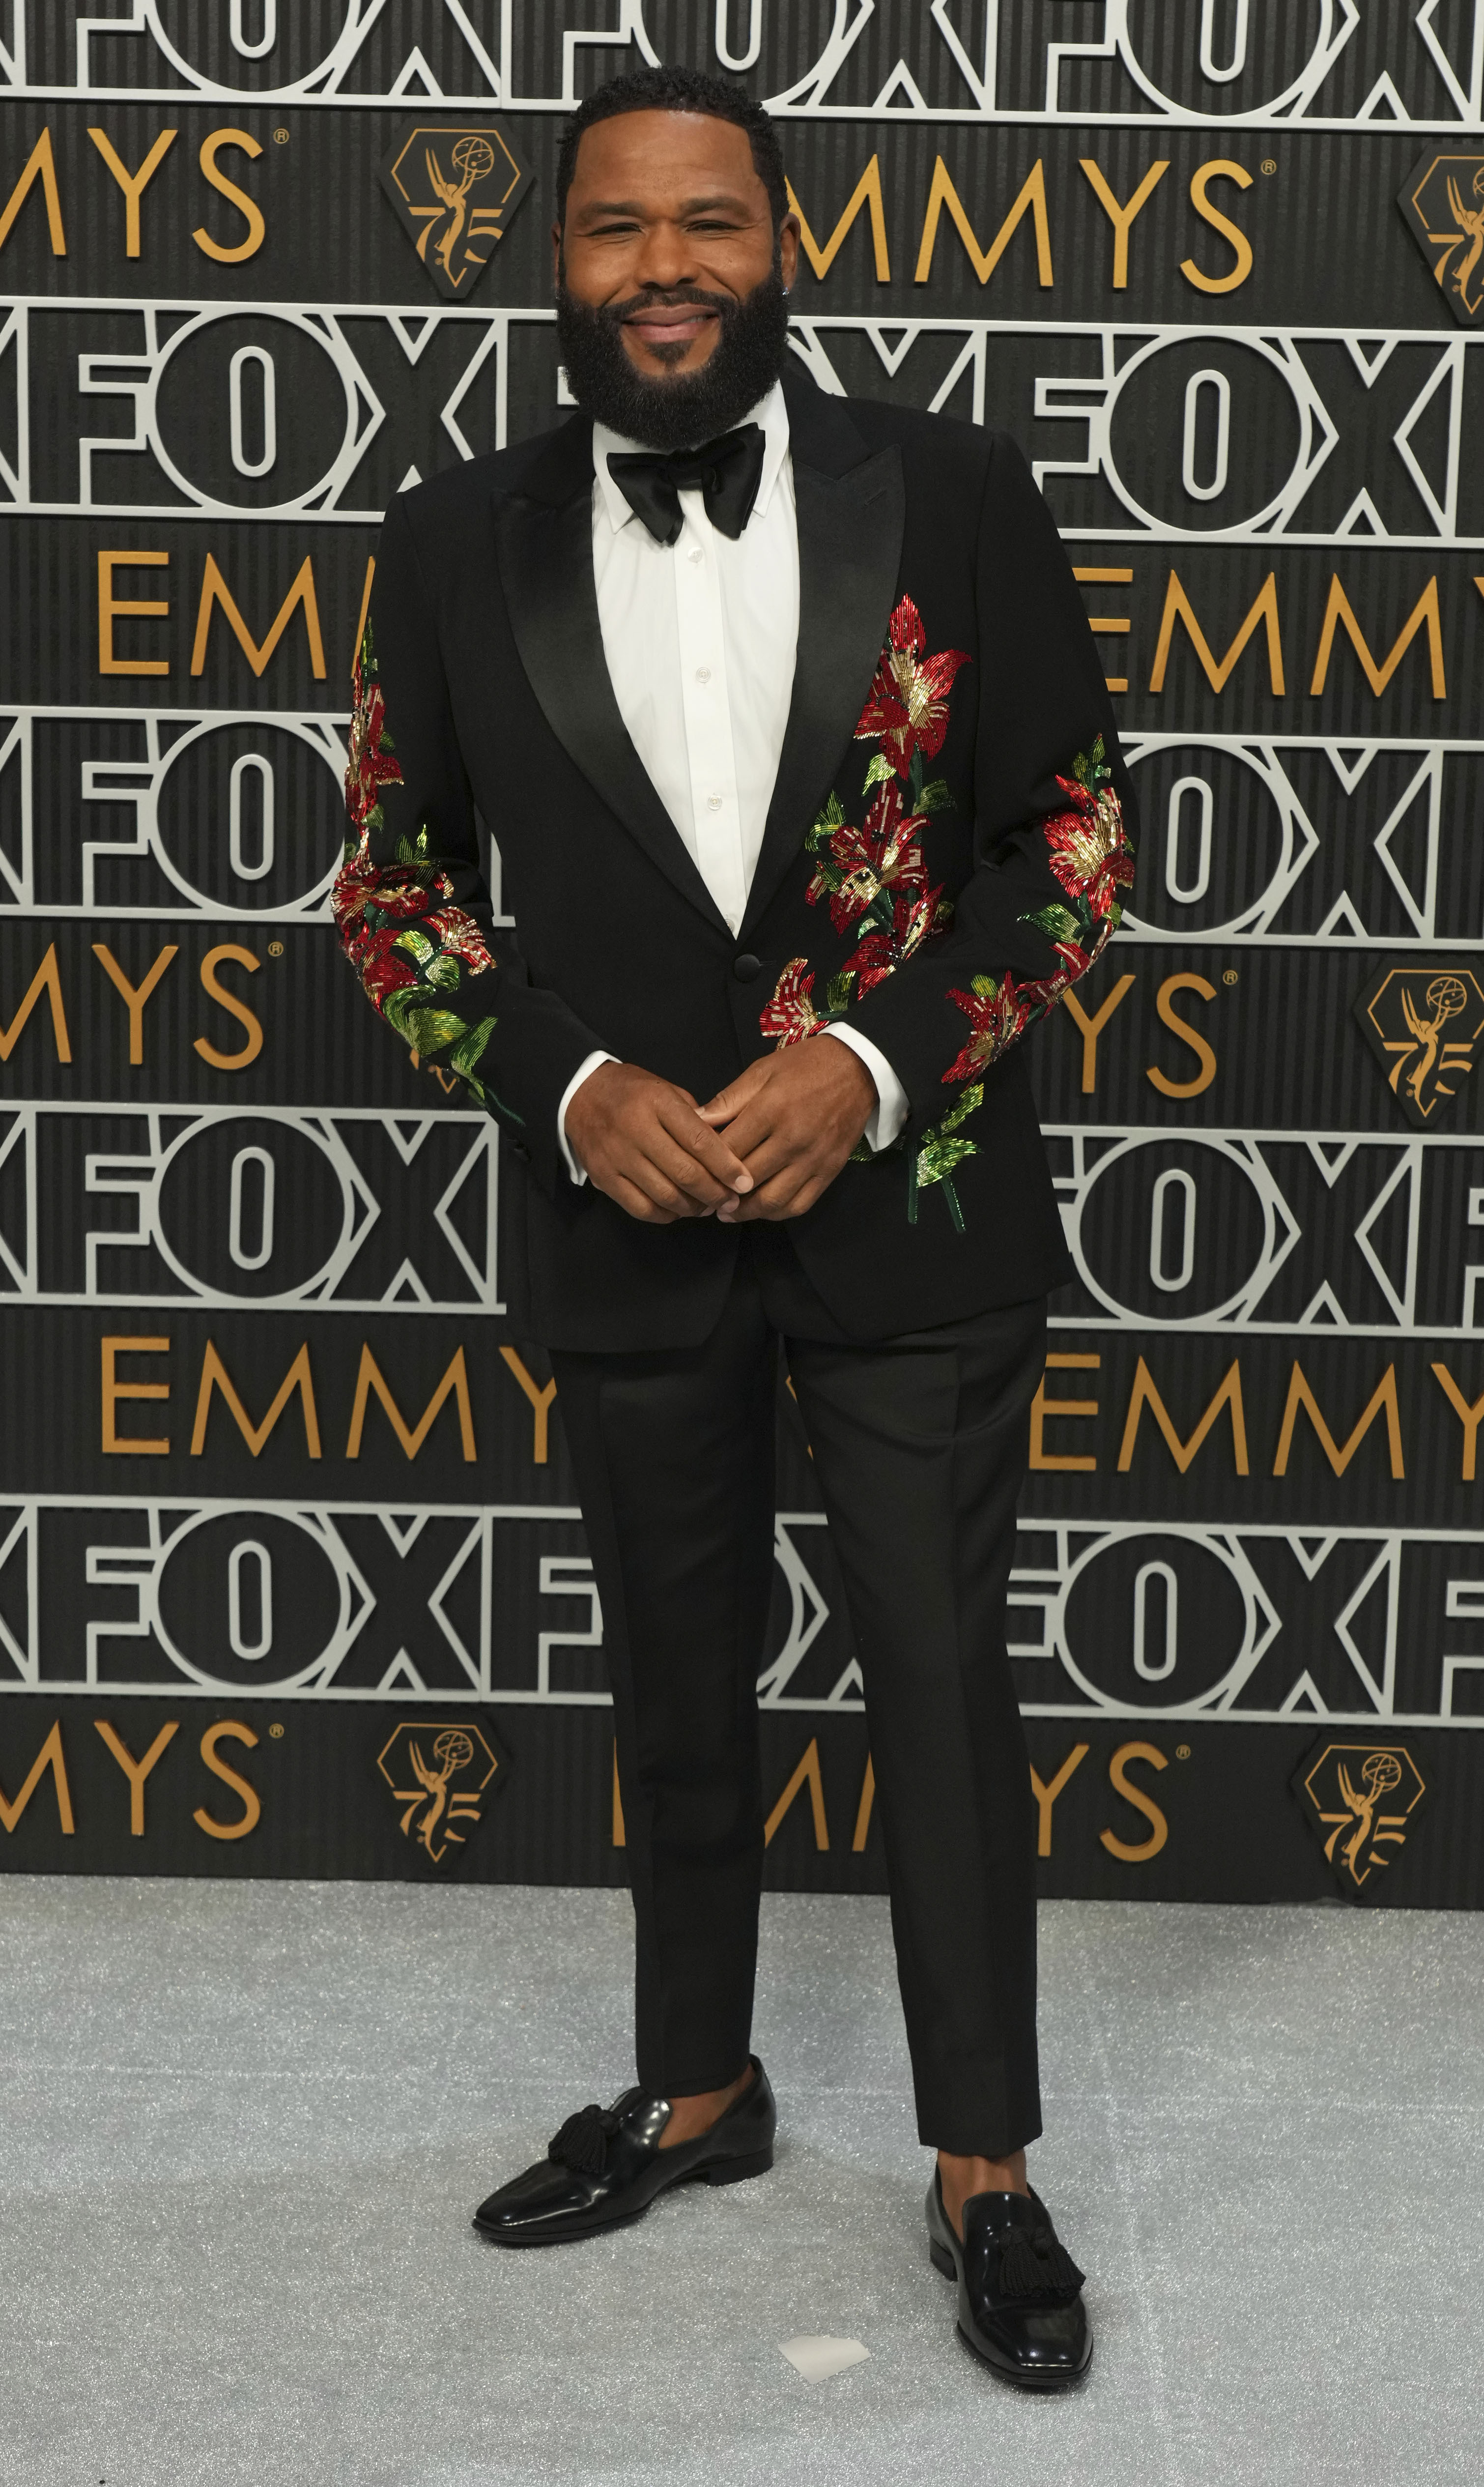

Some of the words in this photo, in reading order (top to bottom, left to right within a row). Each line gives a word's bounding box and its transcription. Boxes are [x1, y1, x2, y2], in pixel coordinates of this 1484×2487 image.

[17, 296, 508, 523] FOX
[98, 550, 376, 679] EM
[26, 1100, 498, 1314] FOX
[28, 1495, 491, 1703] FOX
